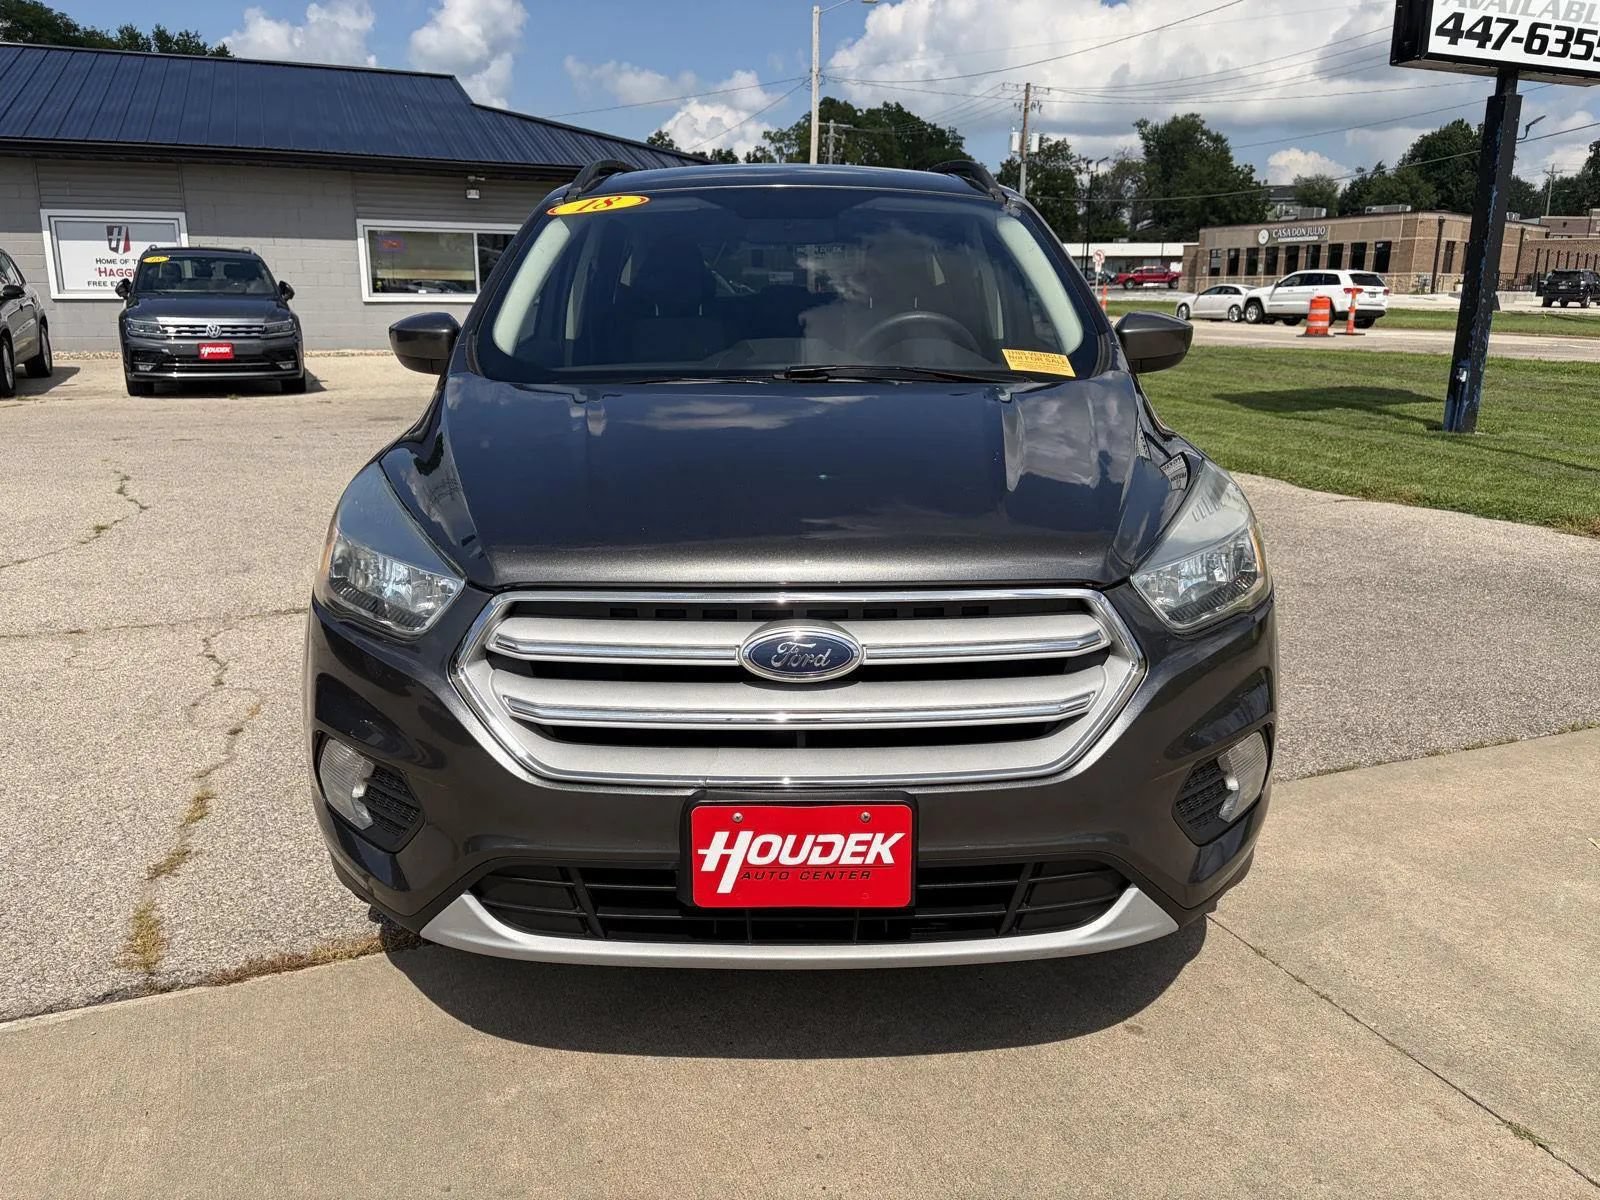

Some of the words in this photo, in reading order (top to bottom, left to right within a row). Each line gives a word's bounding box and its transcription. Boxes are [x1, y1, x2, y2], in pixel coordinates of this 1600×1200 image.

[1435, 12, 1600, 62] 447-635
[1273, 228, 1291, 238] CASA
[1292, 227, 1306, 237] DON
[1307, 225, 1326, 236] JULIO
[771, 641, 832, 668] Ford
[697, 831, 906, 894] HOUDEK
[740, 870, 790, 881] AUTO
[799, 870, 872, 881] CENTER
